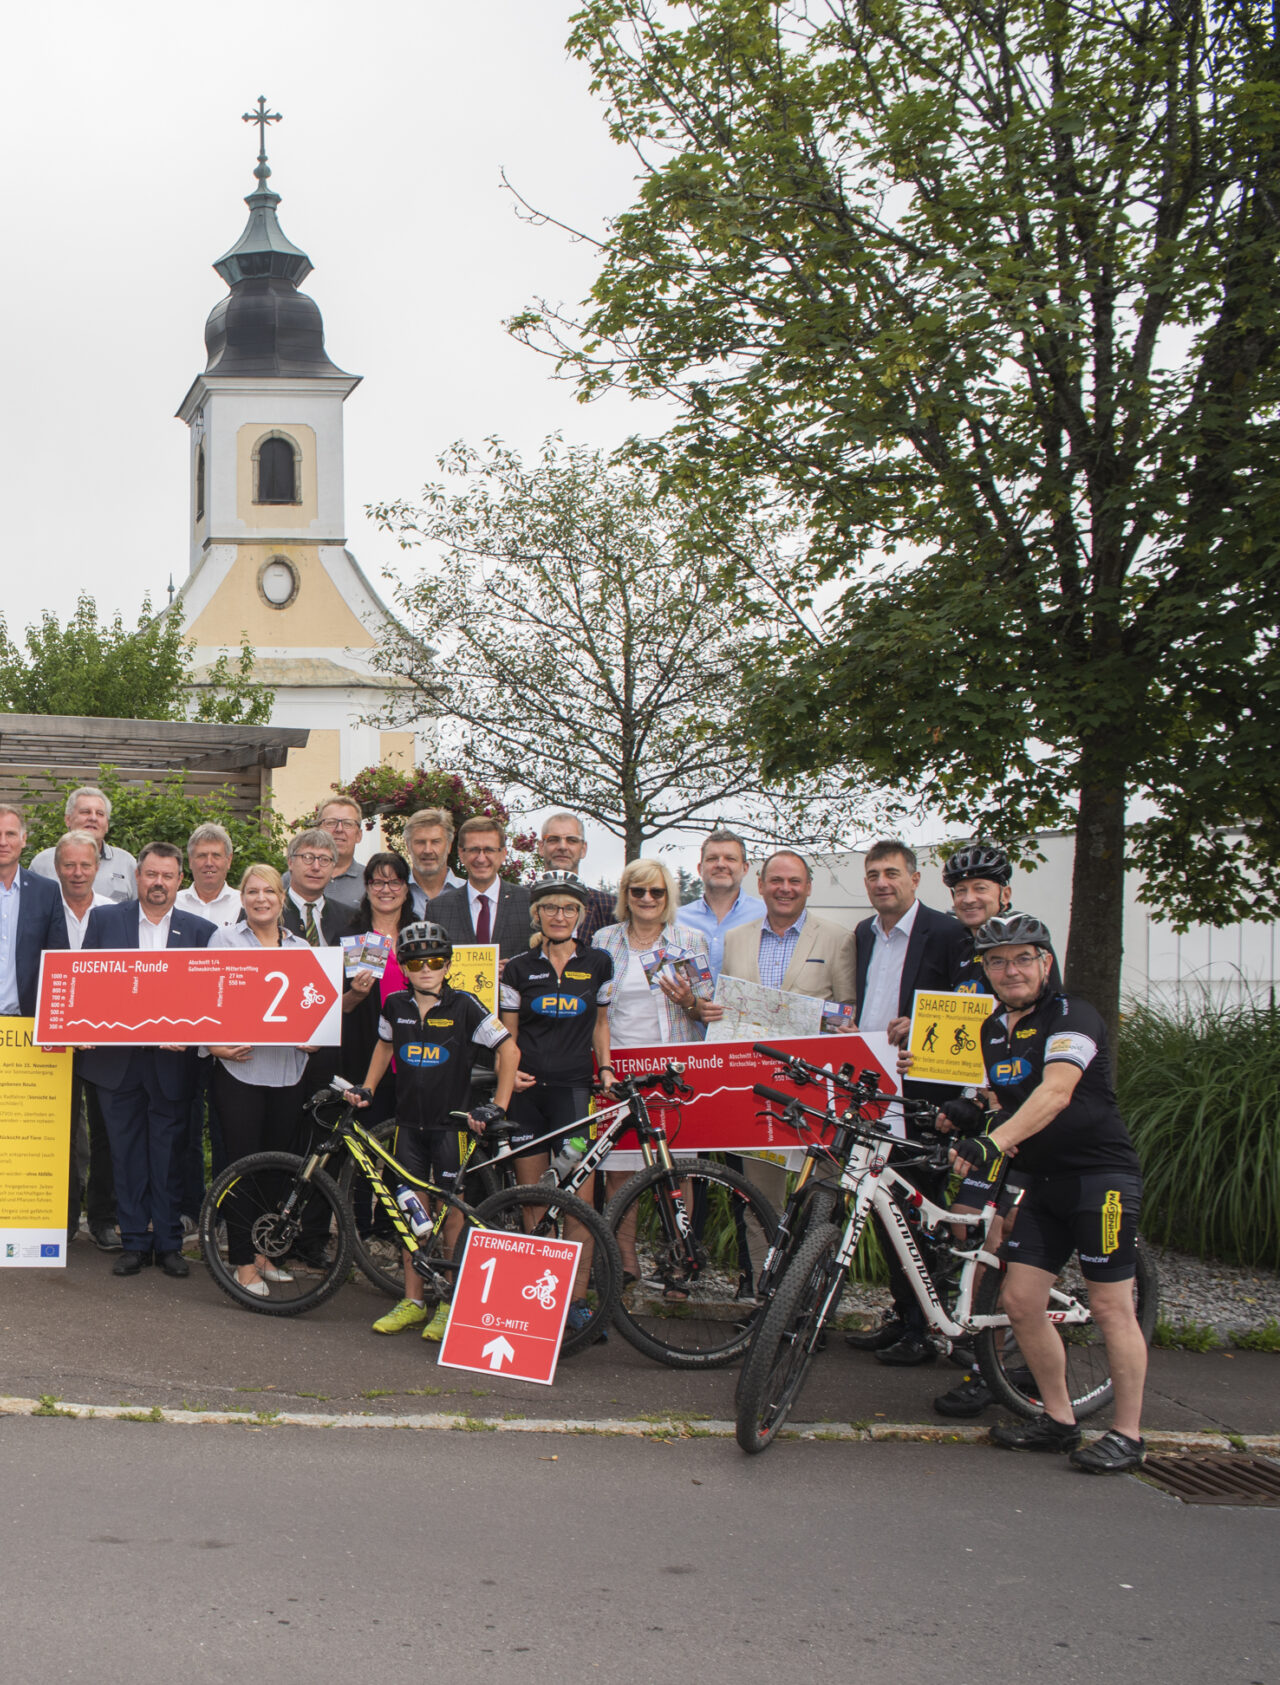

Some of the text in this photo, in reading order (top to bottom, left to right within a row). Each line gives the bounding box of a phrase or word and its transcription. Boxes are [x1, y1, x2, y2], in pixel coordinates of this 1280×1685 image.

[467, 951, 493, 962] TRAIL
[72, 960, 169, 973] GUSENTAL-Runde
[262, 971, 290, 1022] 2
[542, 997, 578, 1010] PM
[919, 999, 989, 1015] SHARED TRAIL
[407, 1045, 440, 1060] PM
[997, 1060, 1021, 1077] PM
[1106, 1192, 1118, 1250] TECHNOGYM
[472, 1235, 574, 1260] STERNGARTL-Runde
[480, 1257, 497, 1304] 1
[495, 1317, 529, 1331] S-MITTE
